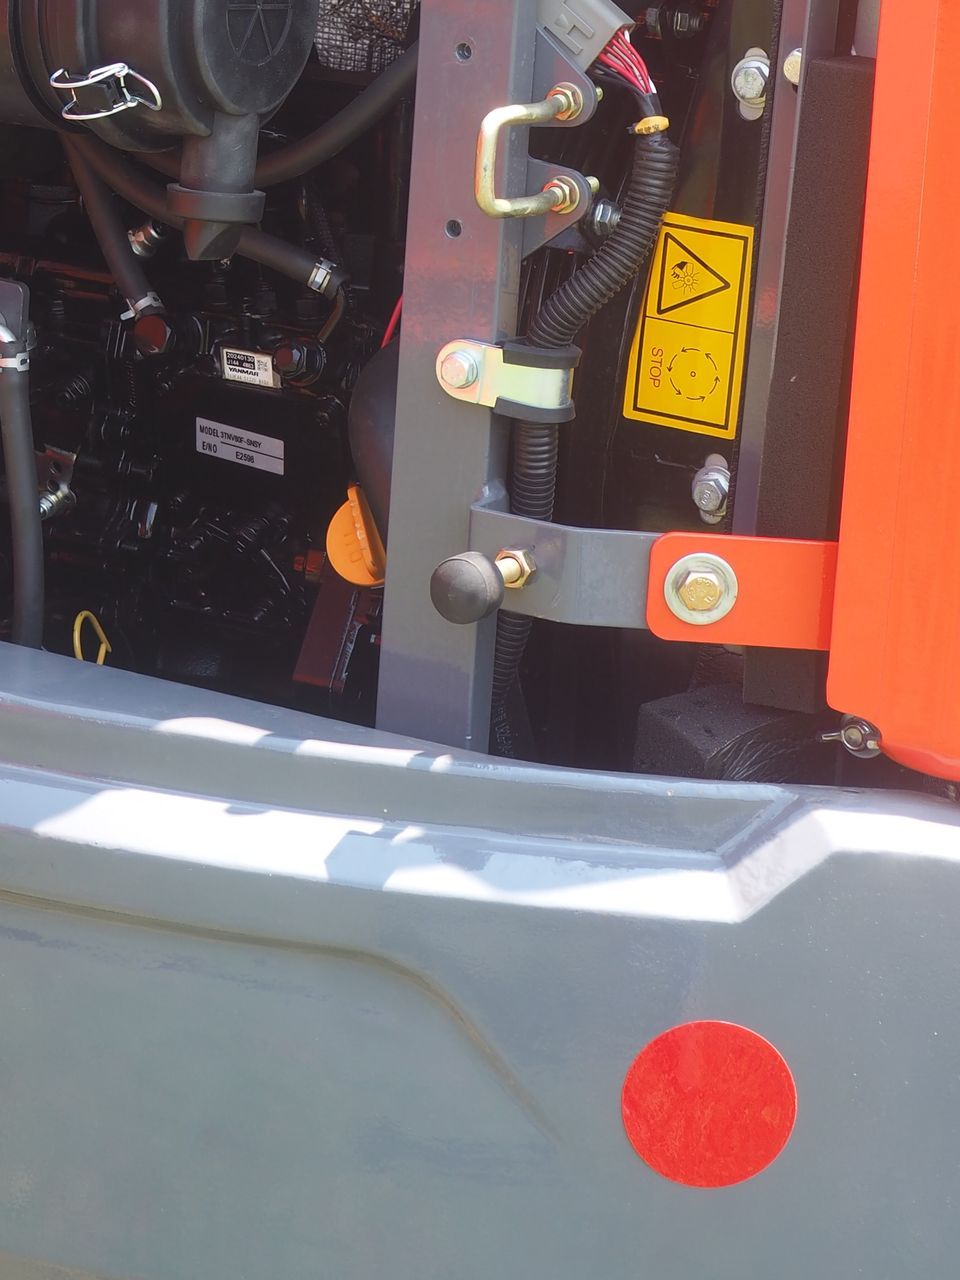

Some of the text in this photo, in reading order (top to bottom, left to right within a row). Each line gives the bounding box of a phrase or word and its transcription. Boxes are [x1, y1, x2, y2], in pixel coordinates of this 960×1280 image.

[228, 366, 259, 377] YANMAR
[649, 347, 663, 388] STOP
[199, 424, 219, 438] MODEL
